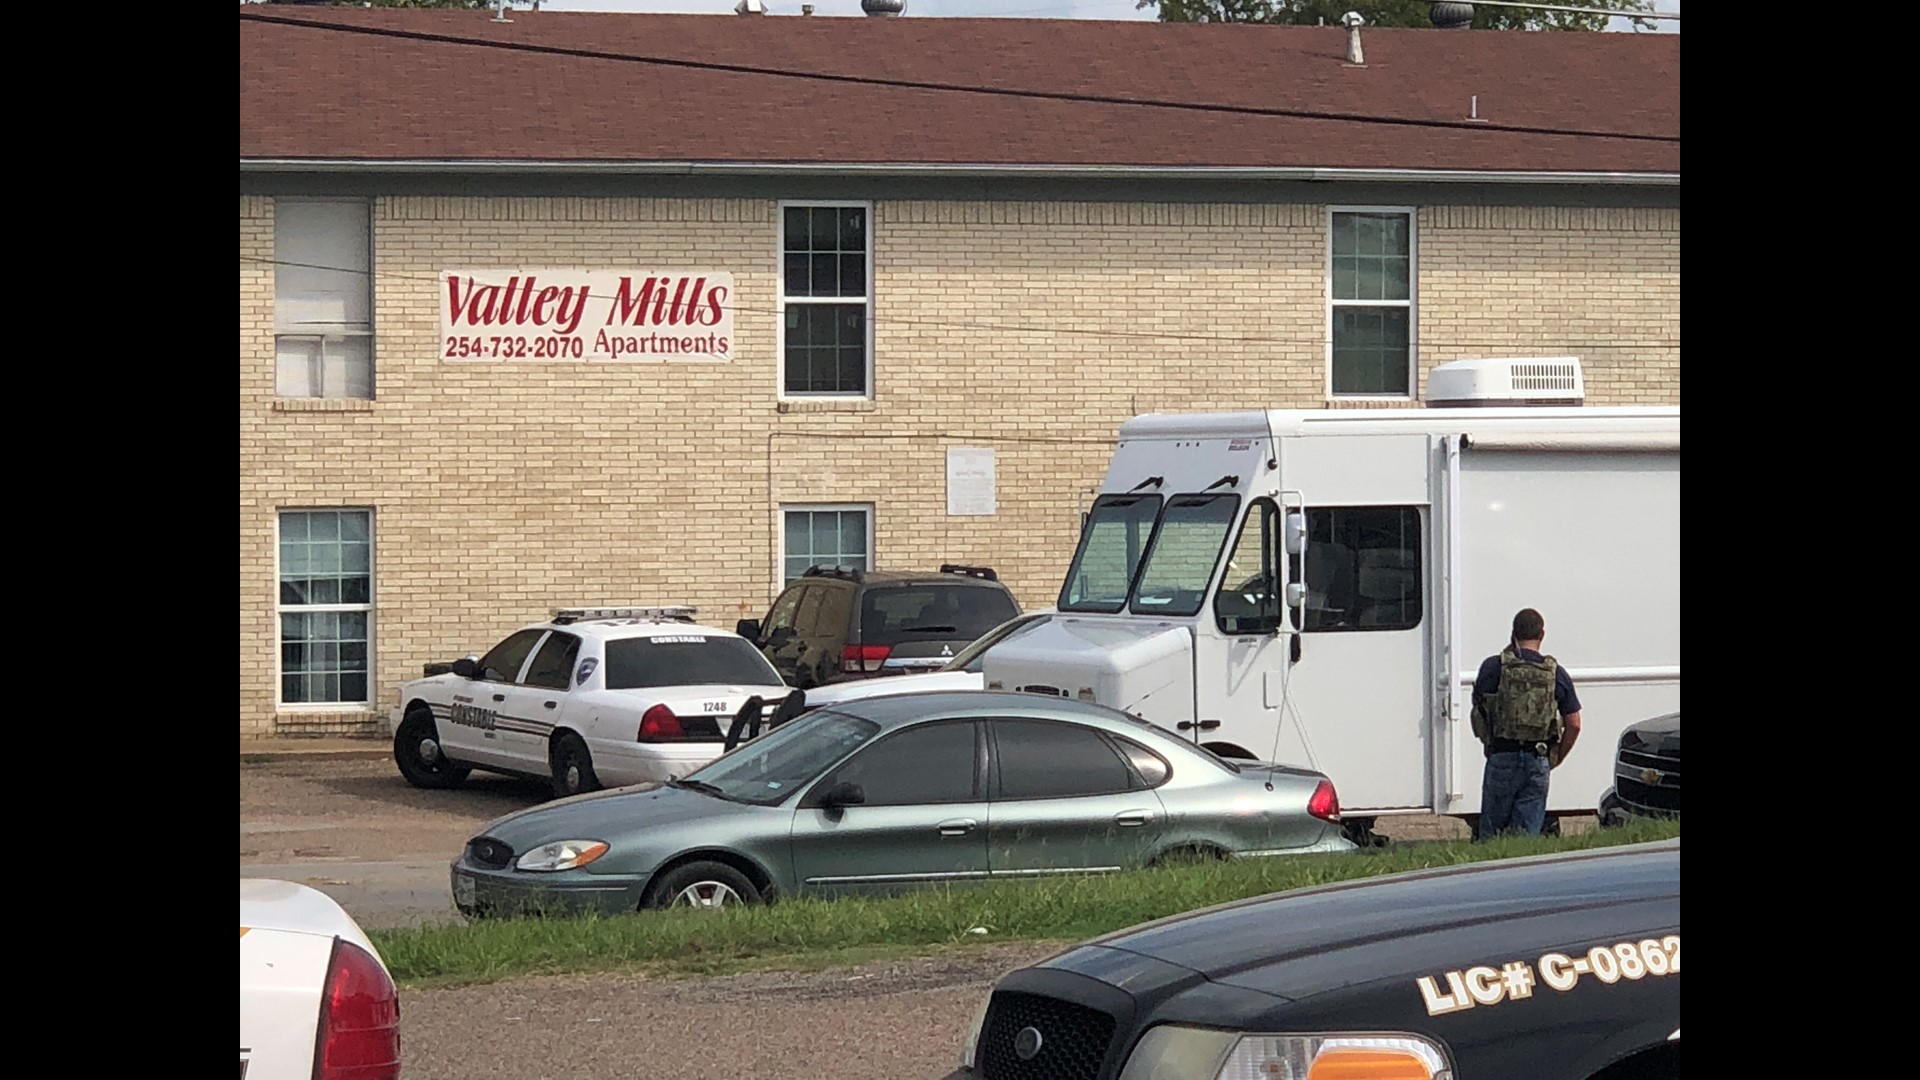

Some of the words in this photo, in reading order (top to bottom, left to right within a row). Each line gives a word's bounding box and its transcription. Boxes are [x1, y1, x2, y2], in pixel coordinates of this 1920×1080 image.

[447, 275, 590, 335] Valley
[605, 276, 728, 327] Mills
[445, 335, 584, 359] 254-732-2070
[593, 328, 729, 359] Apartments
[451, 702, 497, 731] CONSTABLE
[703, 702, 727, 712] 1248
[1416, 960, 1536, 1016] LIC#
[1538, 935, 1680, 991] C-0862
